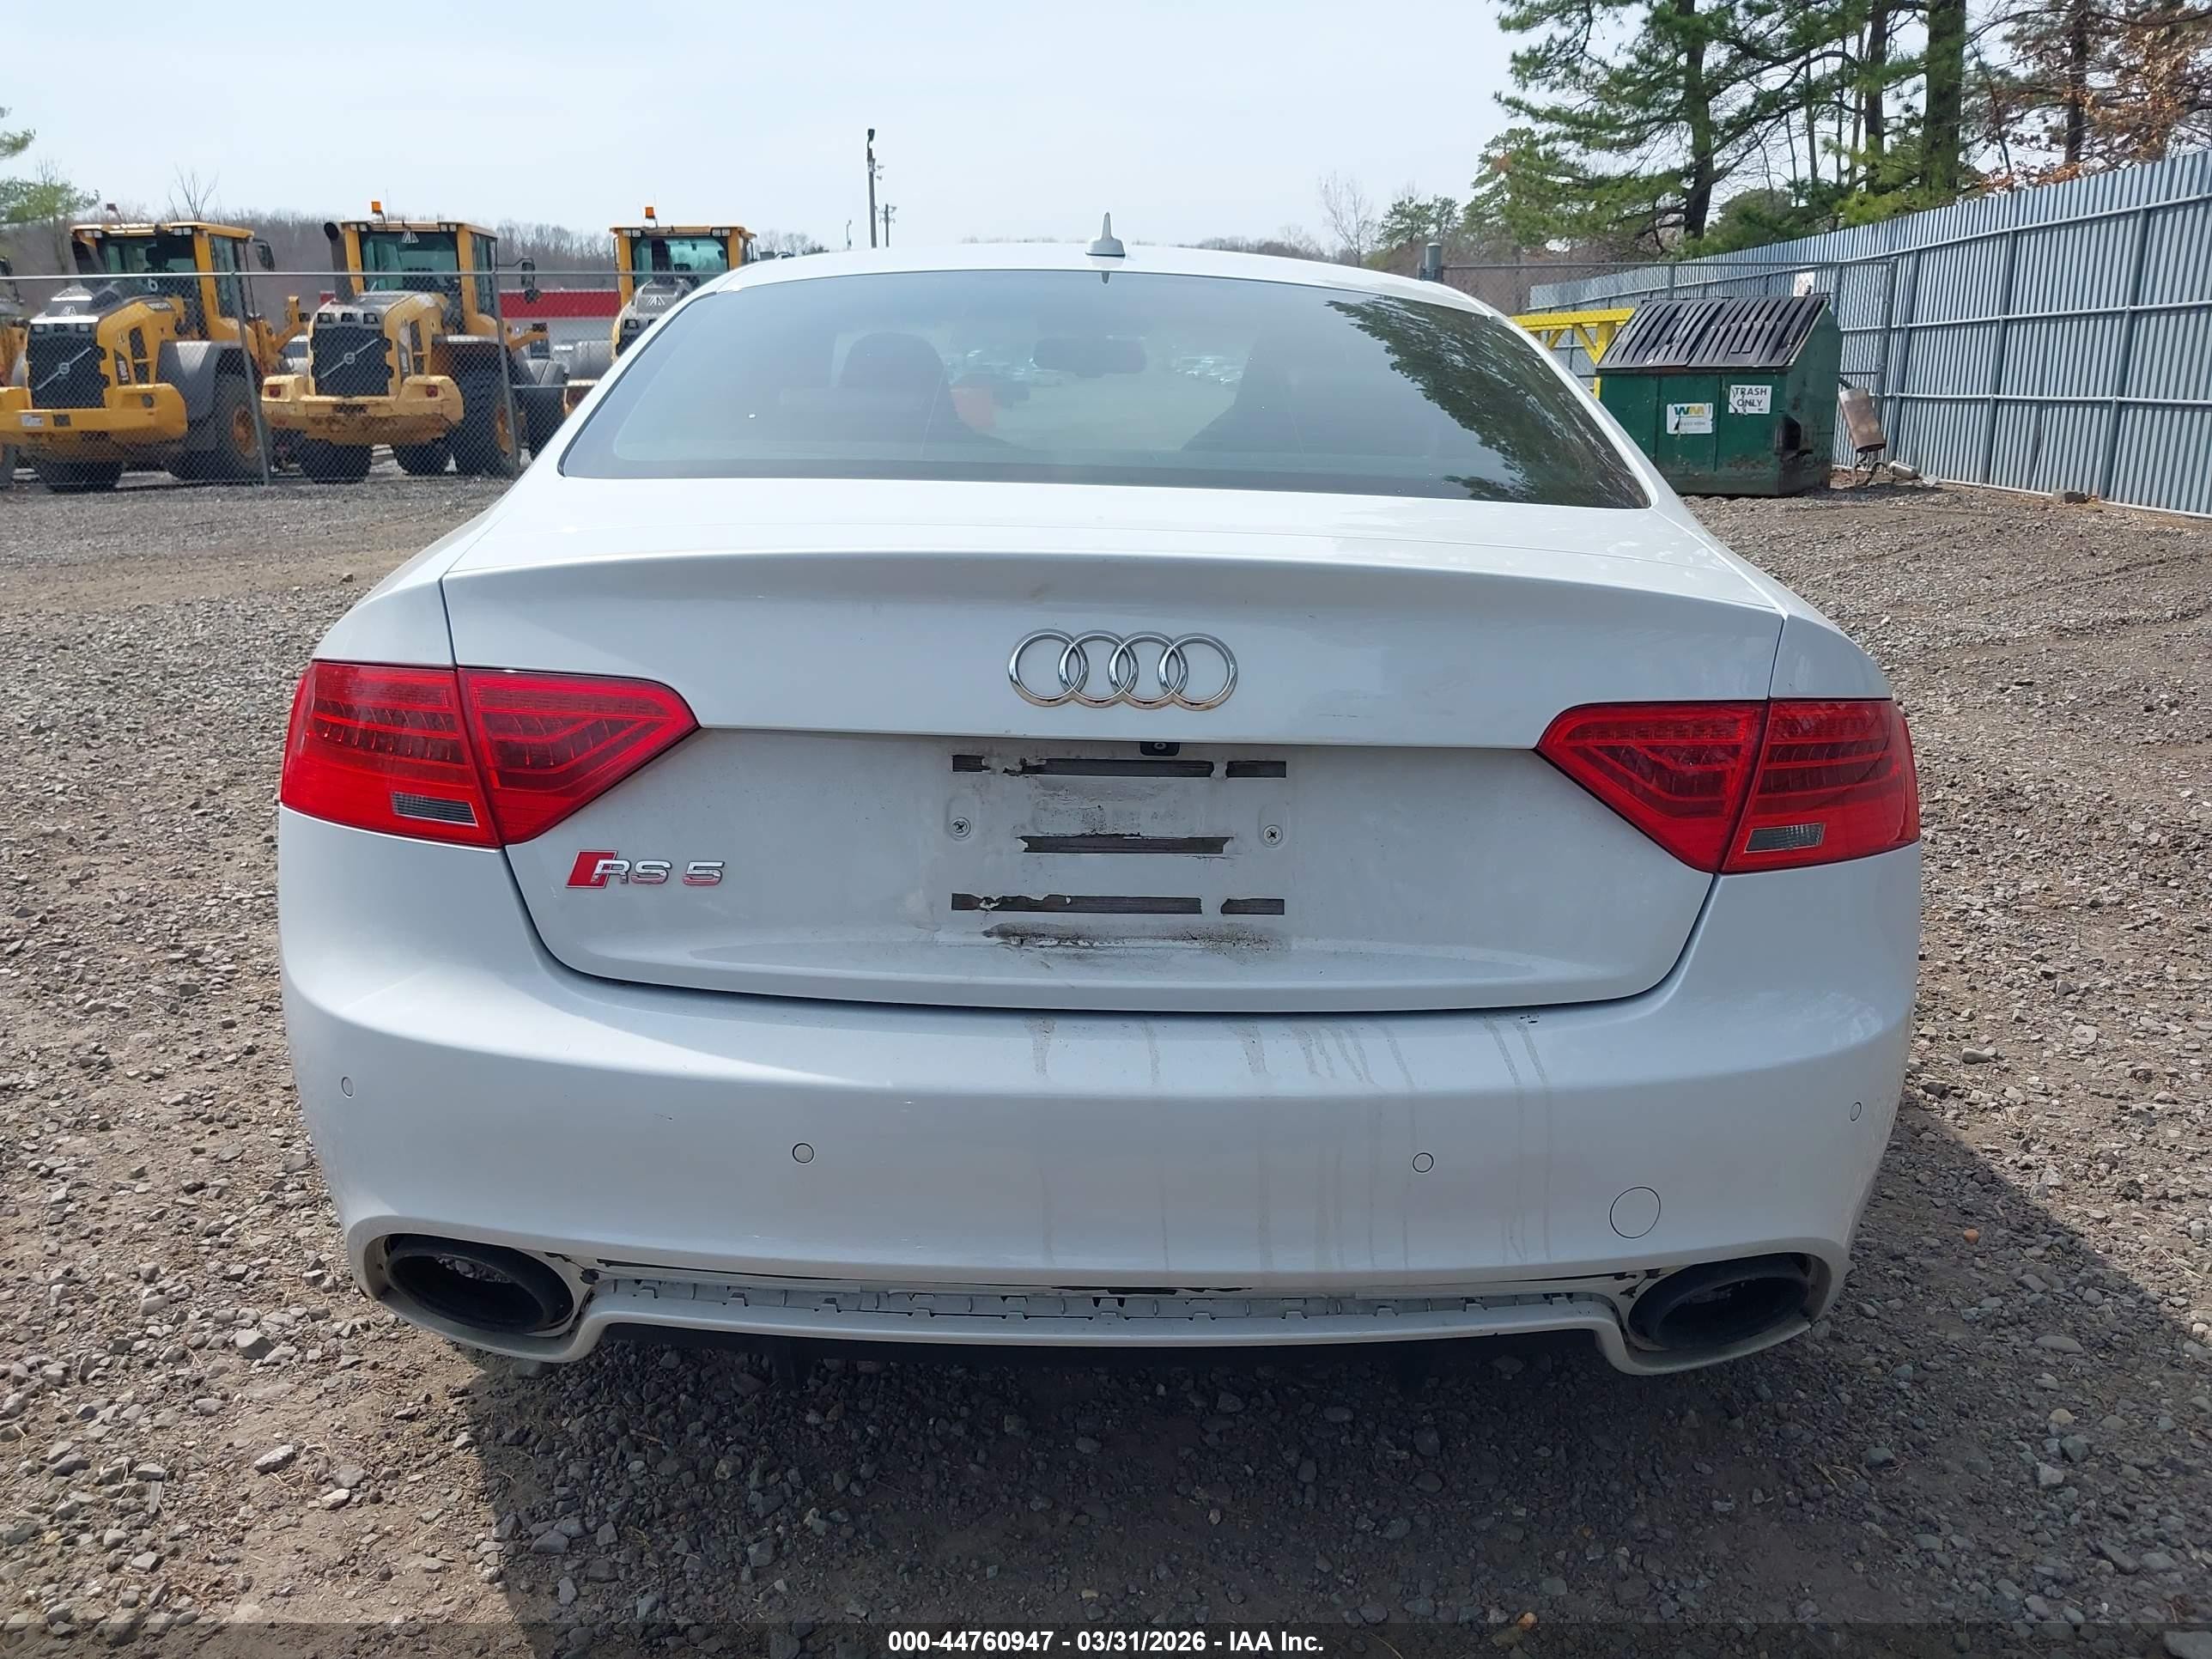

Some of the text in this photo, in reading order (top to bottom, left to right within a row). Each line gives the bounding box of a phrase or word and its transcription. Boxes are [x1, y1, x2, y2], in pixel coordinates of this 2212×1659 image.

[1735, 387, 1767, 396] TRASH
[1736, 398, 1763, 407] ONLY
[1674, 405, 1705, 416] WM
[591, 859, 726, 886] RS 5
